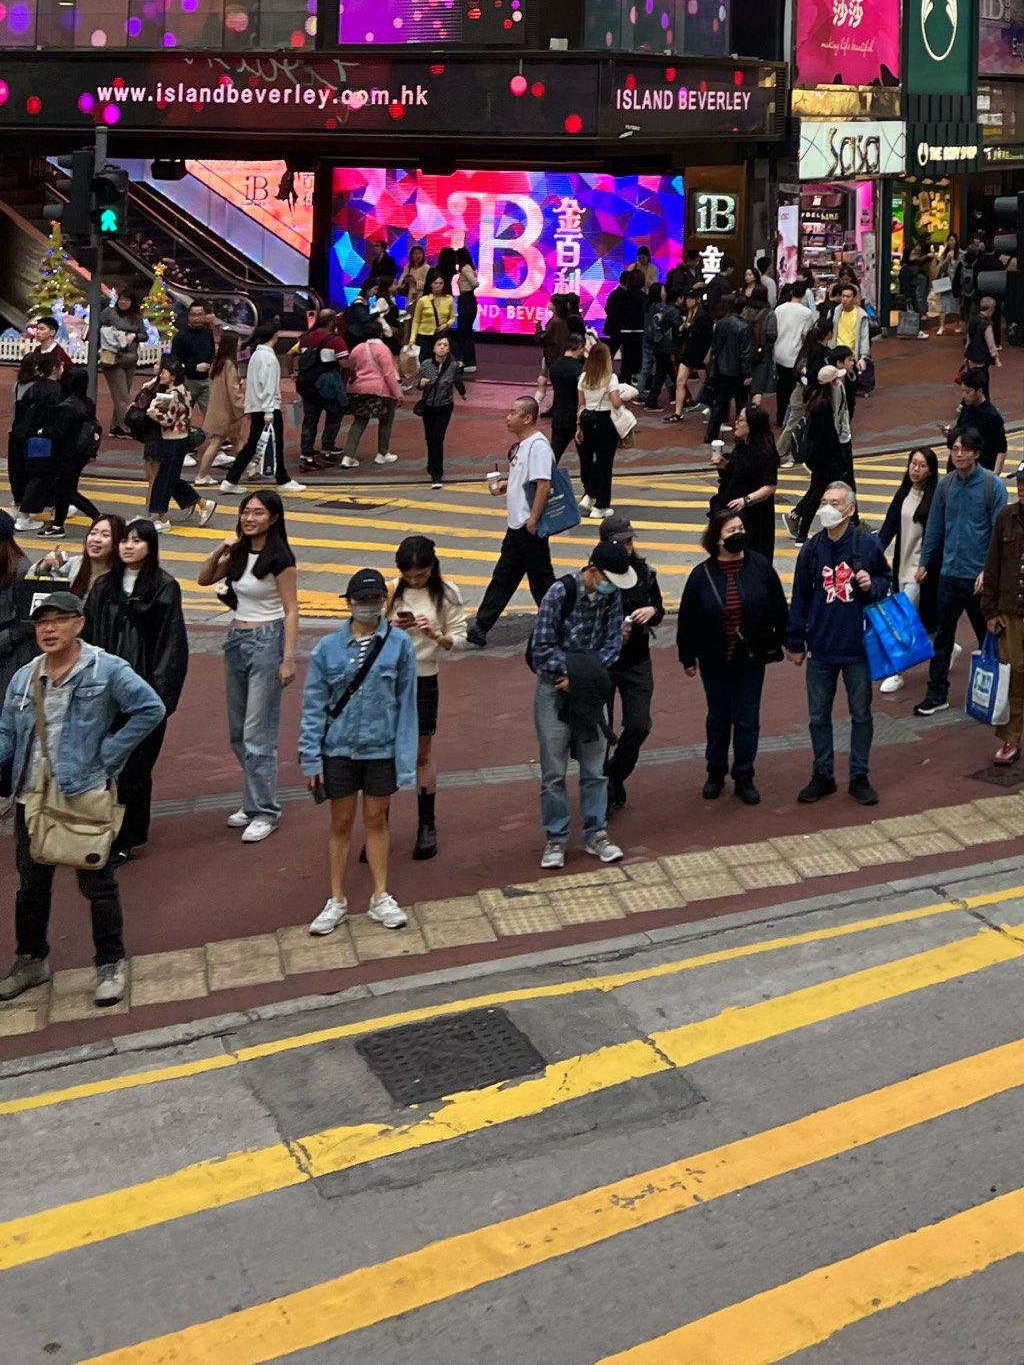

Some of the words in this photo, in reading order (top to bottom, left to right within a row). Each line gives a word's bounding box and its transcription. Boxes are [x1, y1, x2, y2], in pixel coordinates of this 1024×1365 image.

[820, 37, 840, 56] making
[851, 39, 875, 58] beautiful
[98, 82, 428, 109] www.islandbeverley.com.hk
[616, 89, 674, 110] ISLAND
[678, 90, 751, 111] BEVERLEY
[245, 176, 269, 201] iB
[697, 195, 736, 232] iB
[507, 305, 553, 321] BEVE
